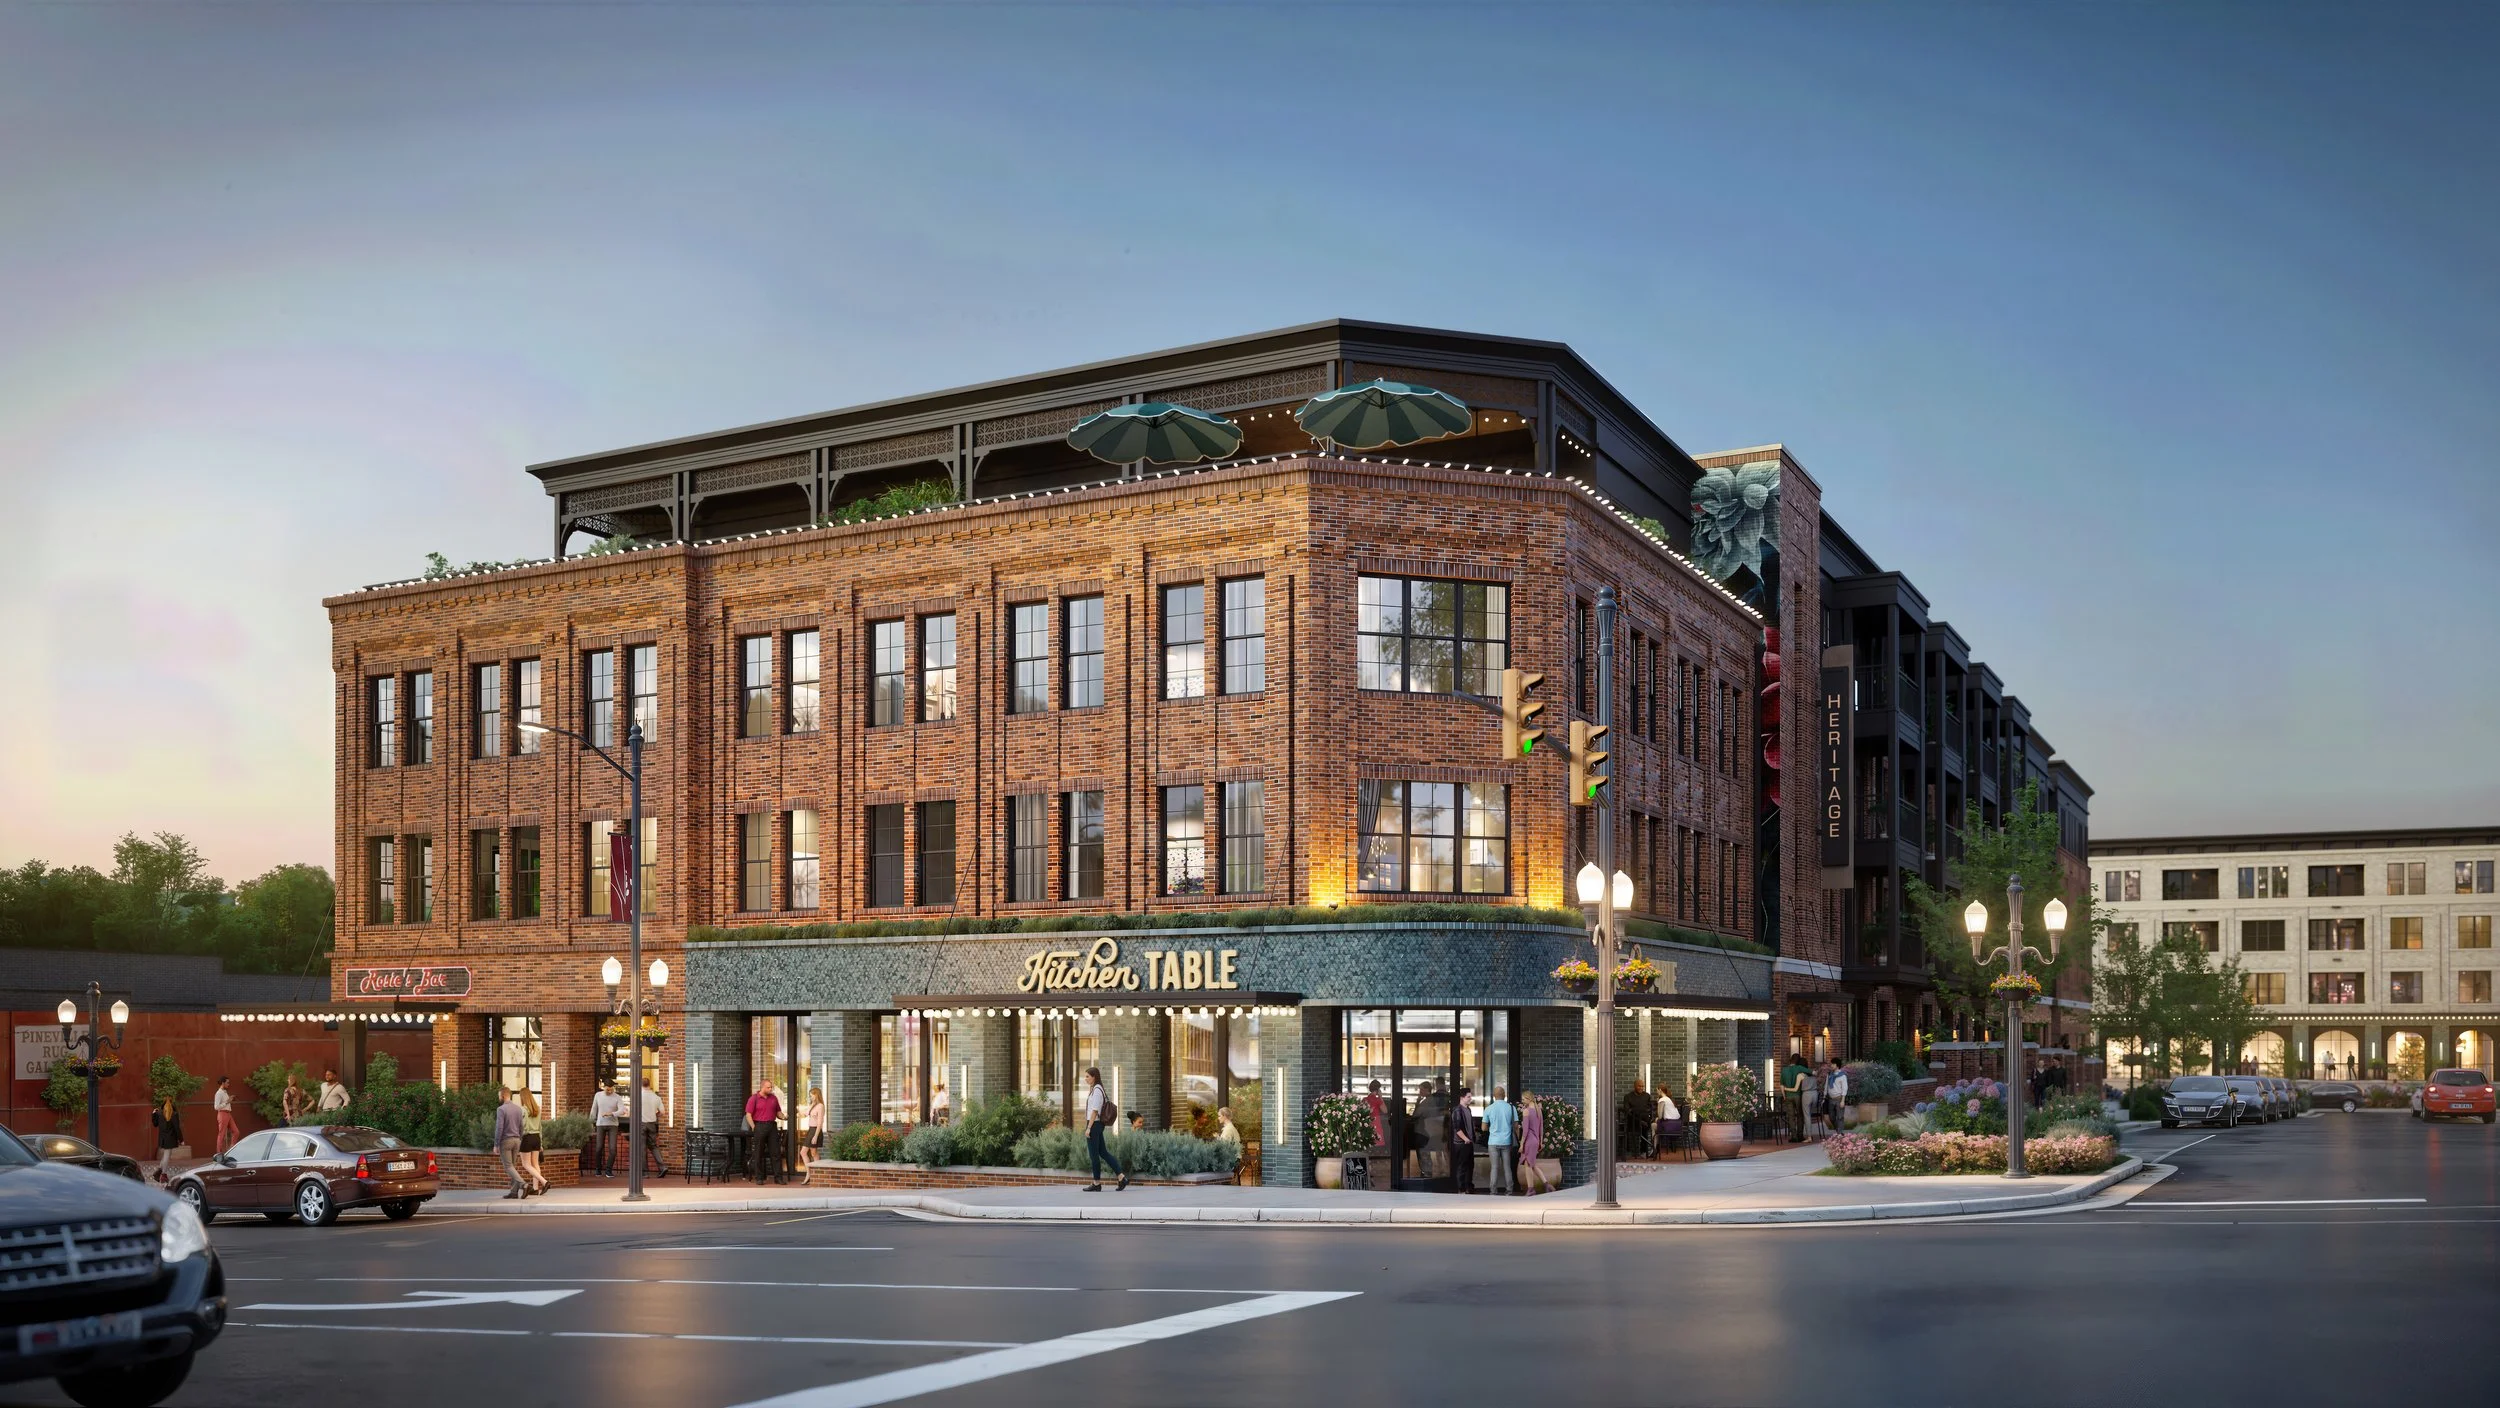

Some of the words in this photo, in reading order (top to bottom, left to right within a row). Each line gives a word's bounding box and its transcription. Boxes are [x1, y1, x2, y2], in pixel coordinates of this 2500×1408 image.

[1827, 694, 1841, 838] HERITAGE
[1017, 937, 1140, 994] Kitchen
[1144, 949, 1239, 990] TABLE
[360, 969, 413, 993] Rosie's
[413, 968, 447, 996] Bar
[22, 1031, 89, 1043] PINEVIL
[43, 1046, 68, 1058] RUG
